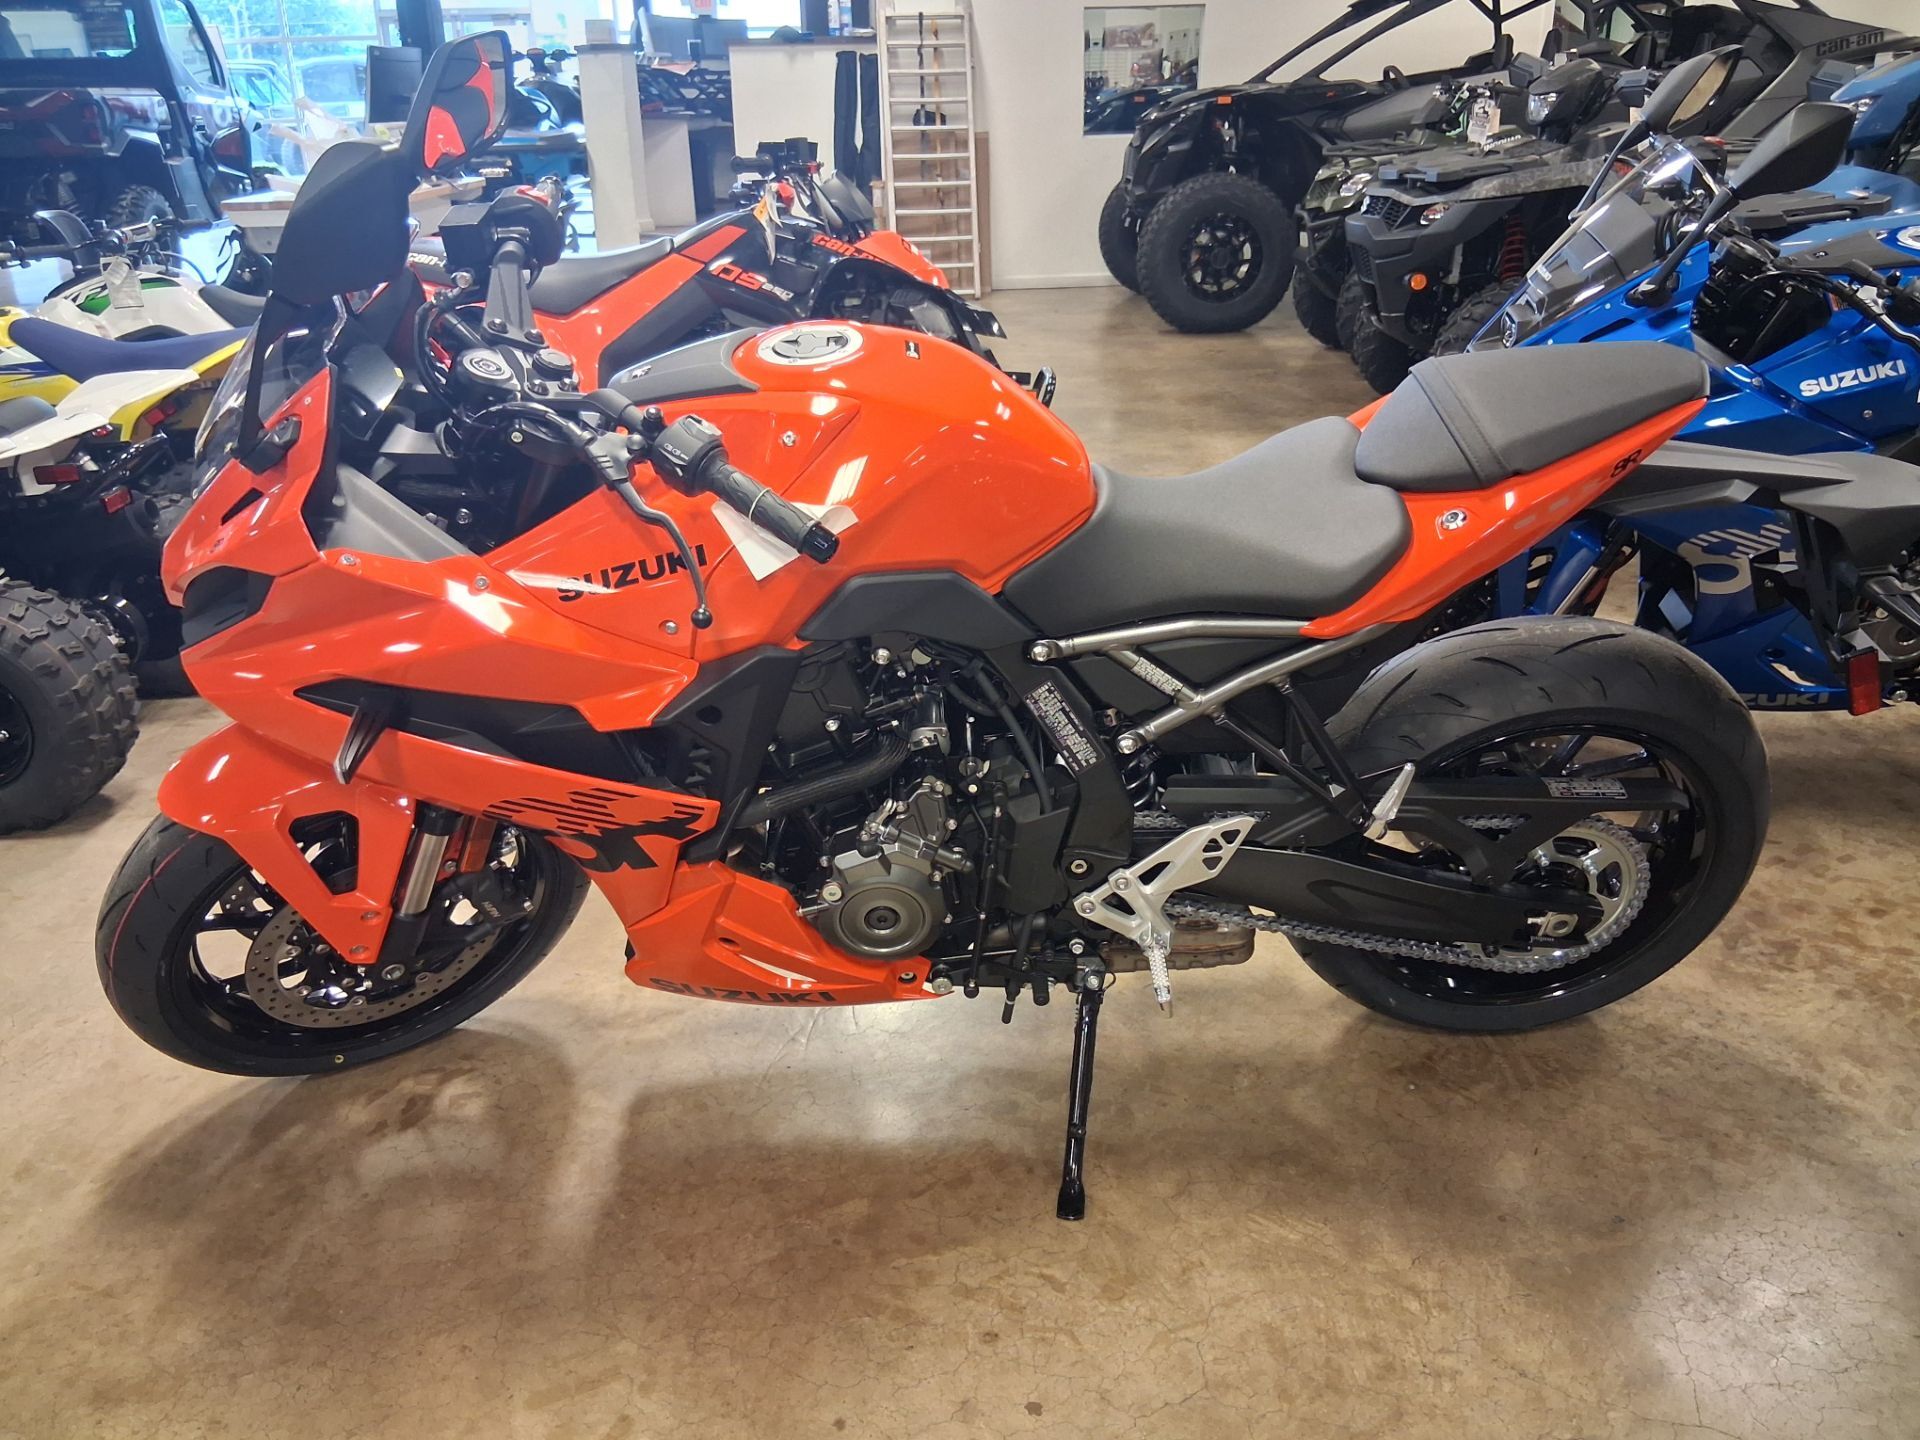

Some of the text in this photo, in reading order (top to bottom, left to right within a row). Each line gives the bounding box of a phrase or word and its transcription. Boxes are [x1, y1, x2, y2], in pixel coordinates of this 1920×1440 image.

[1816, 31, 1885, 57] can-am
[1799, 359, 1906, 397] SUZUKI
[1738, 691, 1830, 706] ZUKI
[649, 977, 838, 1004] SUZUKI
